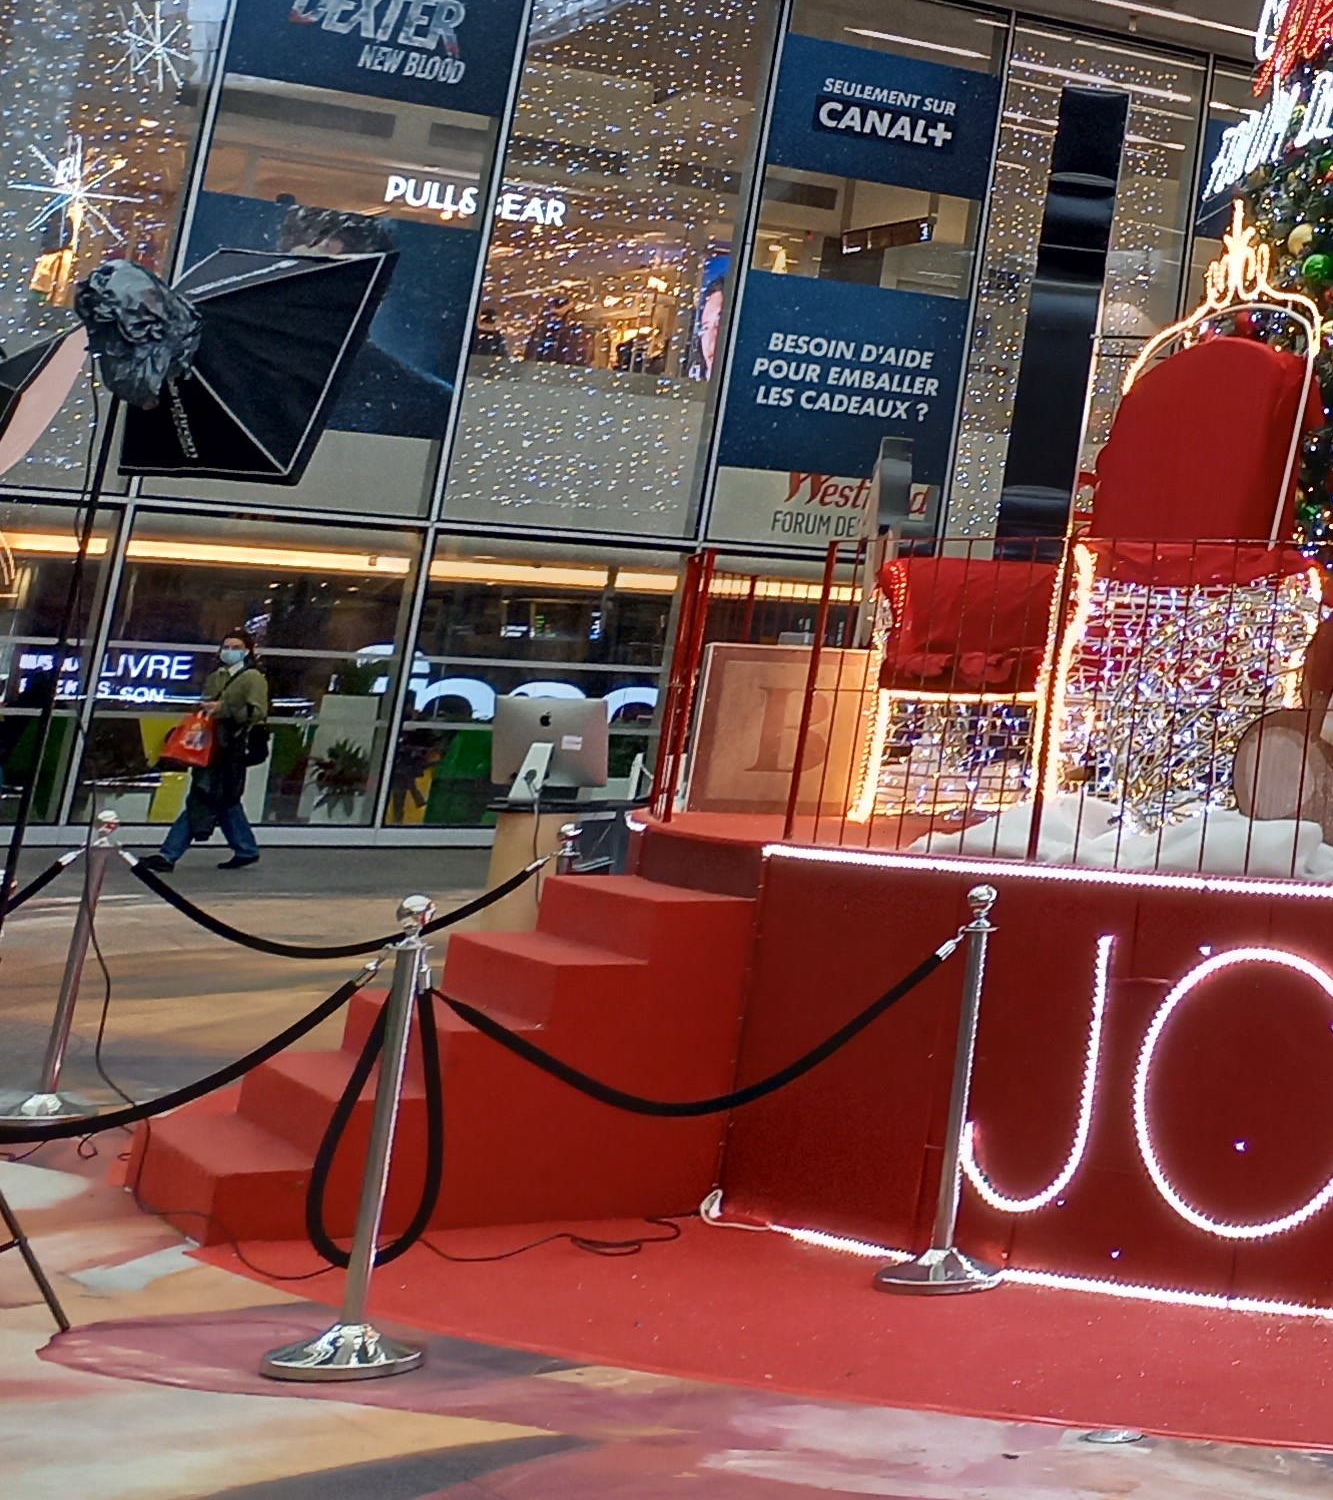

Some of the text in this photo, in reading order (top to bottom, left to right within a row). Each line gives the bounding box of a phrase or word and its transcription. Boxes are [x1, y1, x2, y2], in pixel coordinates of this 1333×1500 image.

[357, 44, 466, 85] NEW BLOOD
[822, 77, 956, 117] SEULEMENT SUR
[818, 100, 953, 147] CANAL+
[768, 332, 934, 371] BESOIN D'AIDE
[752, 357, 939, 397] POUR EMBALLER
[756, 385, 928, 422] LES CADEAUX ?
[770, 510, 864, 538] FORUM DE
[100, 654, 192, 680] LIVRE
[745, 686, 829, 772] B
